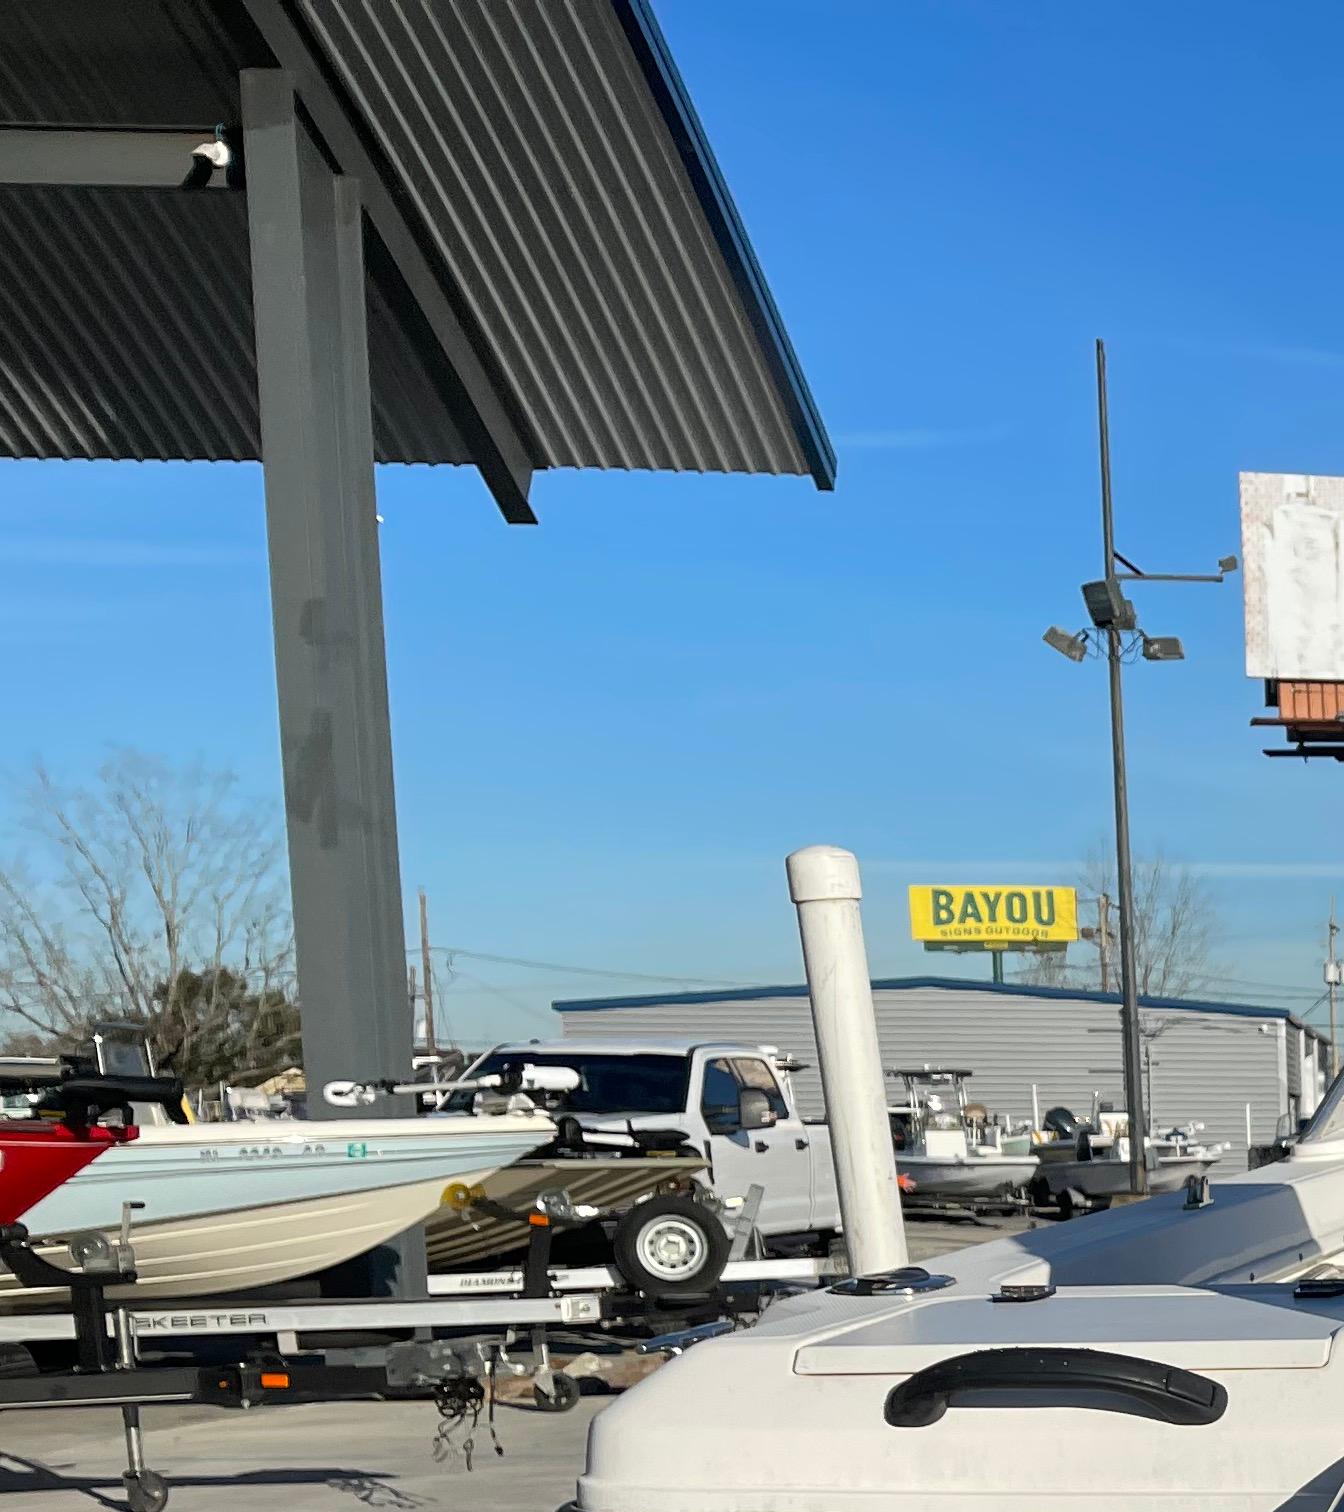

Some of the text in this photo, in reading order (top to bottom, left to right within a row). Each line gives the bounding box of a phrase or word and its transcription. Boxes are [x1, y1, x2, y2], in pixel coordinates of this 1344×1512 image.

[931, 889, 1056, 926] BAYOU
[940, 926, 1049, 938] SIGNS OUTDOOR
[460, 1277, 516, 1287] DIAMON
[135, 1313, 267, 1329] SKEETER
